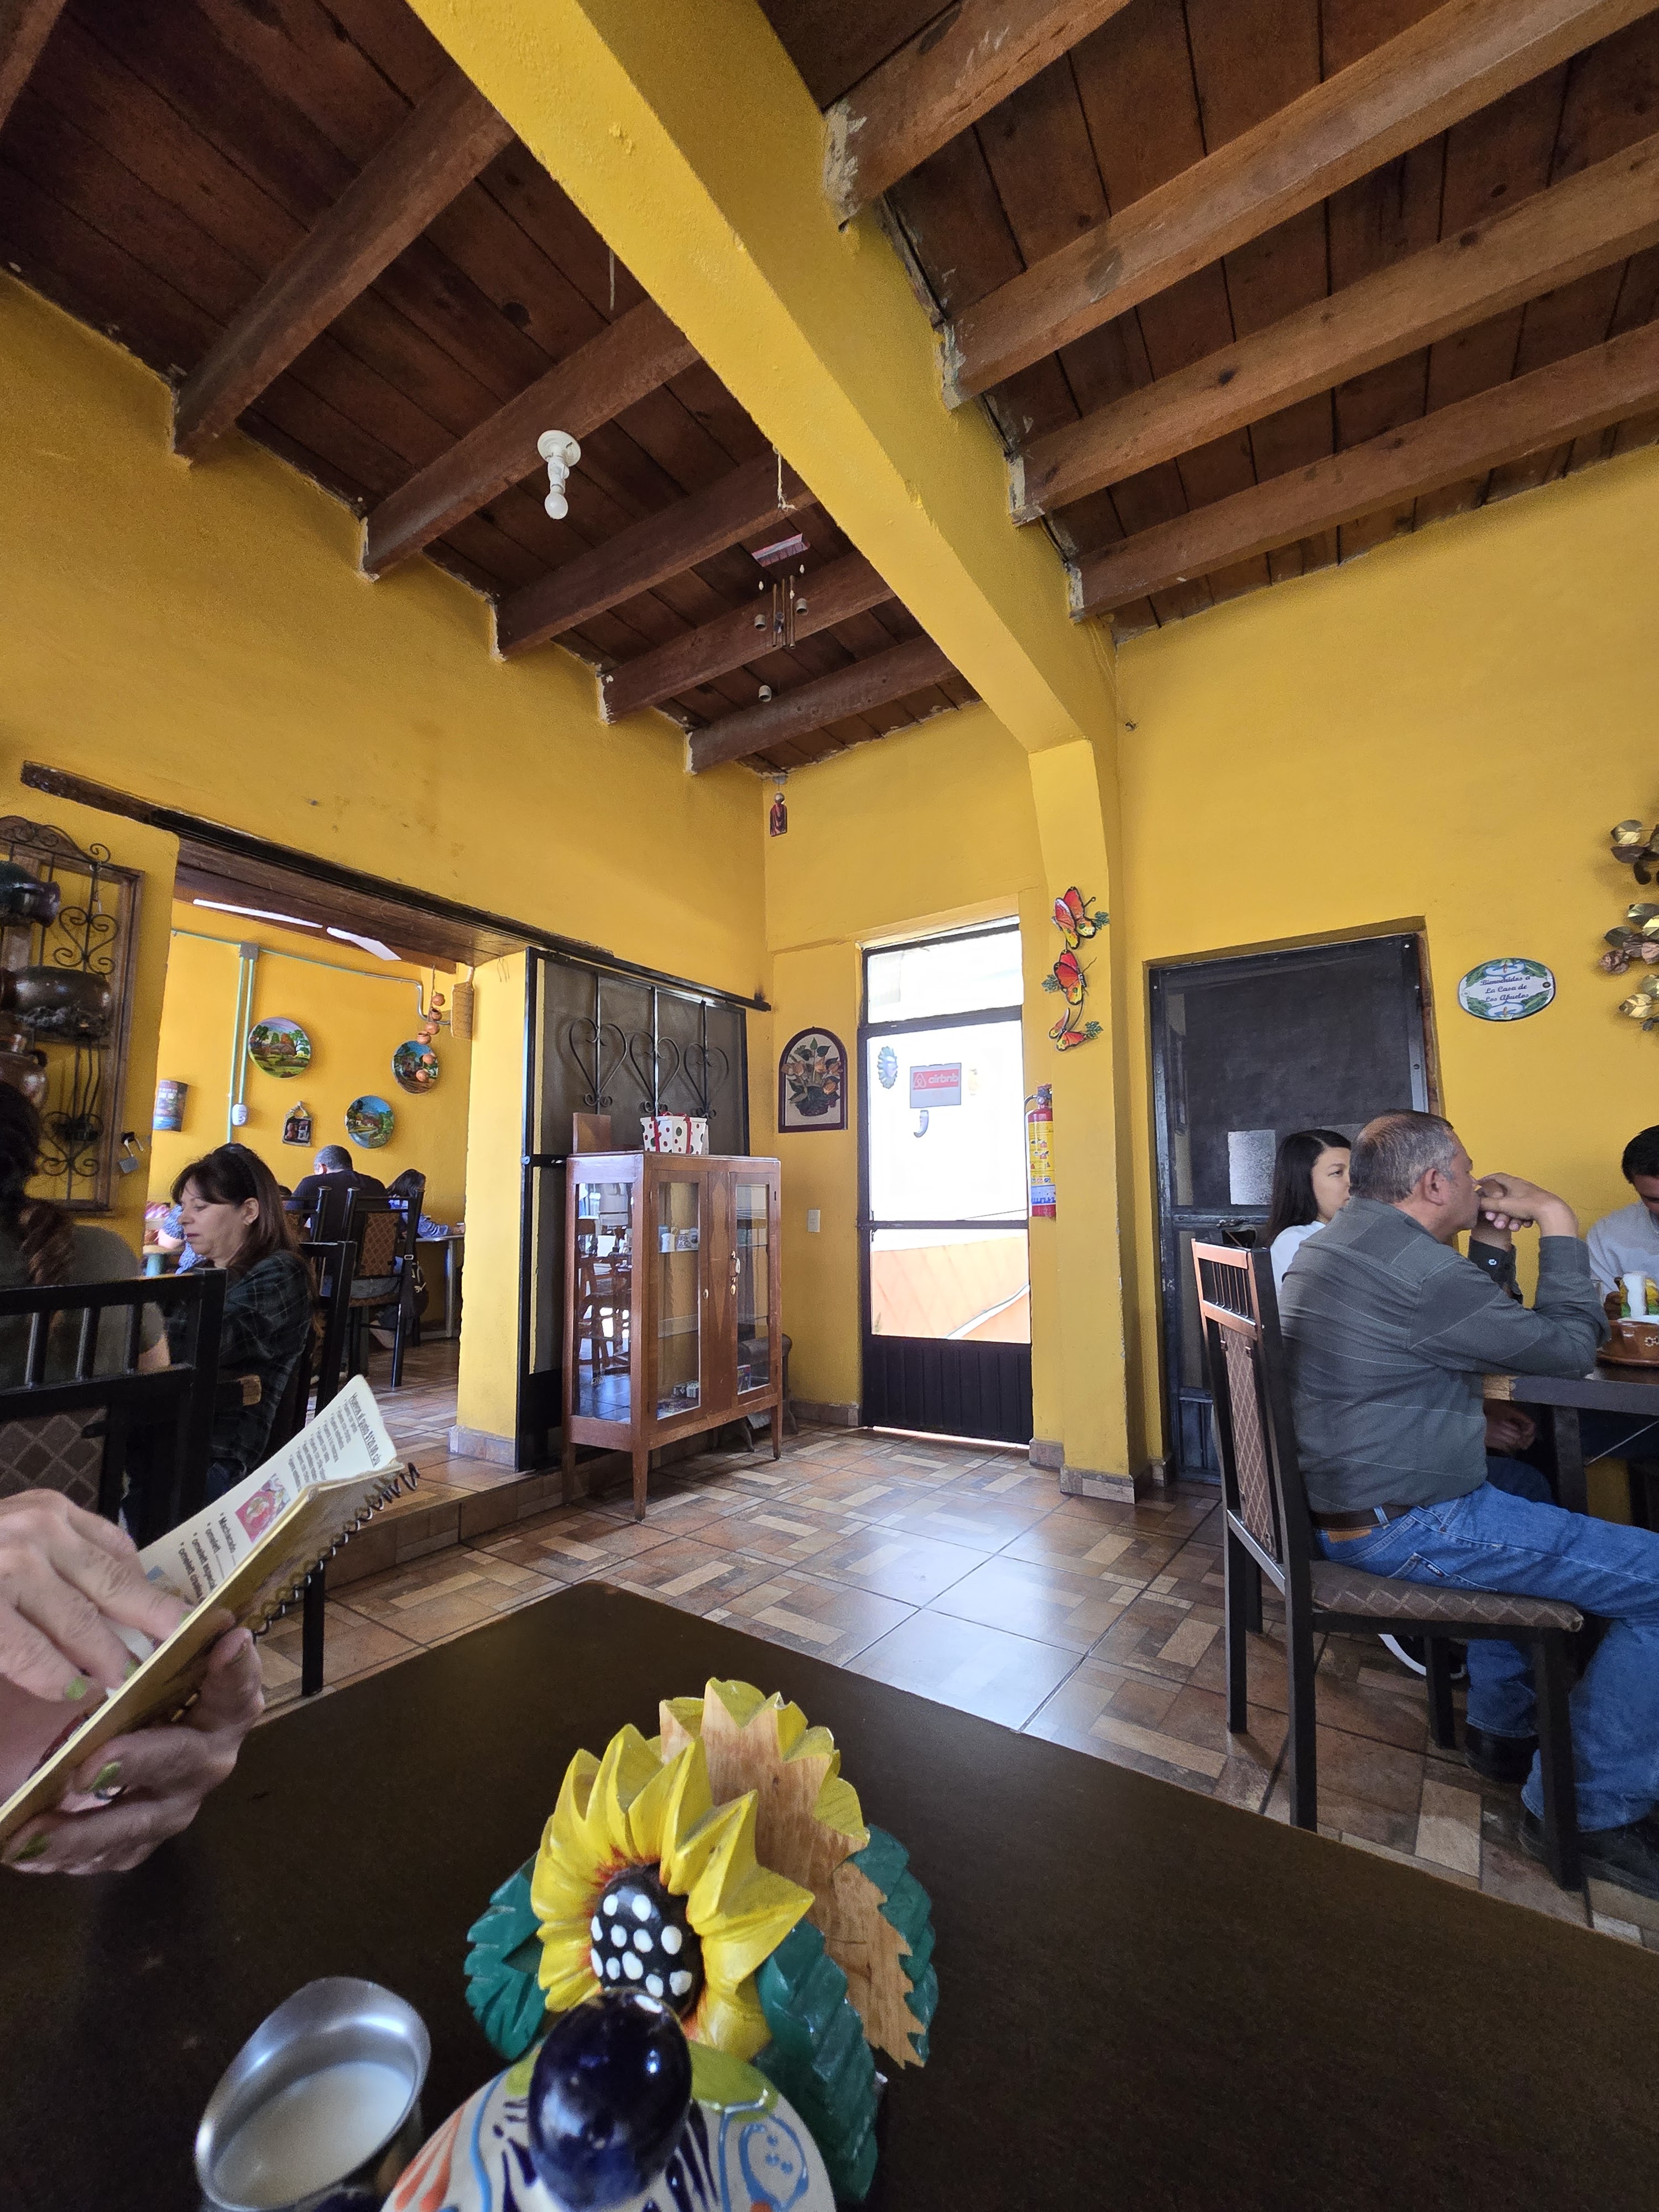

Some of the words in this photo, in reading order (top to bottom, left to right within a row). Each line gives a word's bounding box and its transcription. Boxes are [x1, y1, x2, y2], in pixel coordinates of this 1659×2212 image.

[1479, 975, 1522, 985] Bienvenidos
[928, 1073, 958, 1084] airbnb
[349, 1392, 362, 1415] Huevos
[358, 1418, 369, 1435] gusto
[365, 1431, 379, 1455] $120.00
[218, 1516, 237, 1553] Machacado
